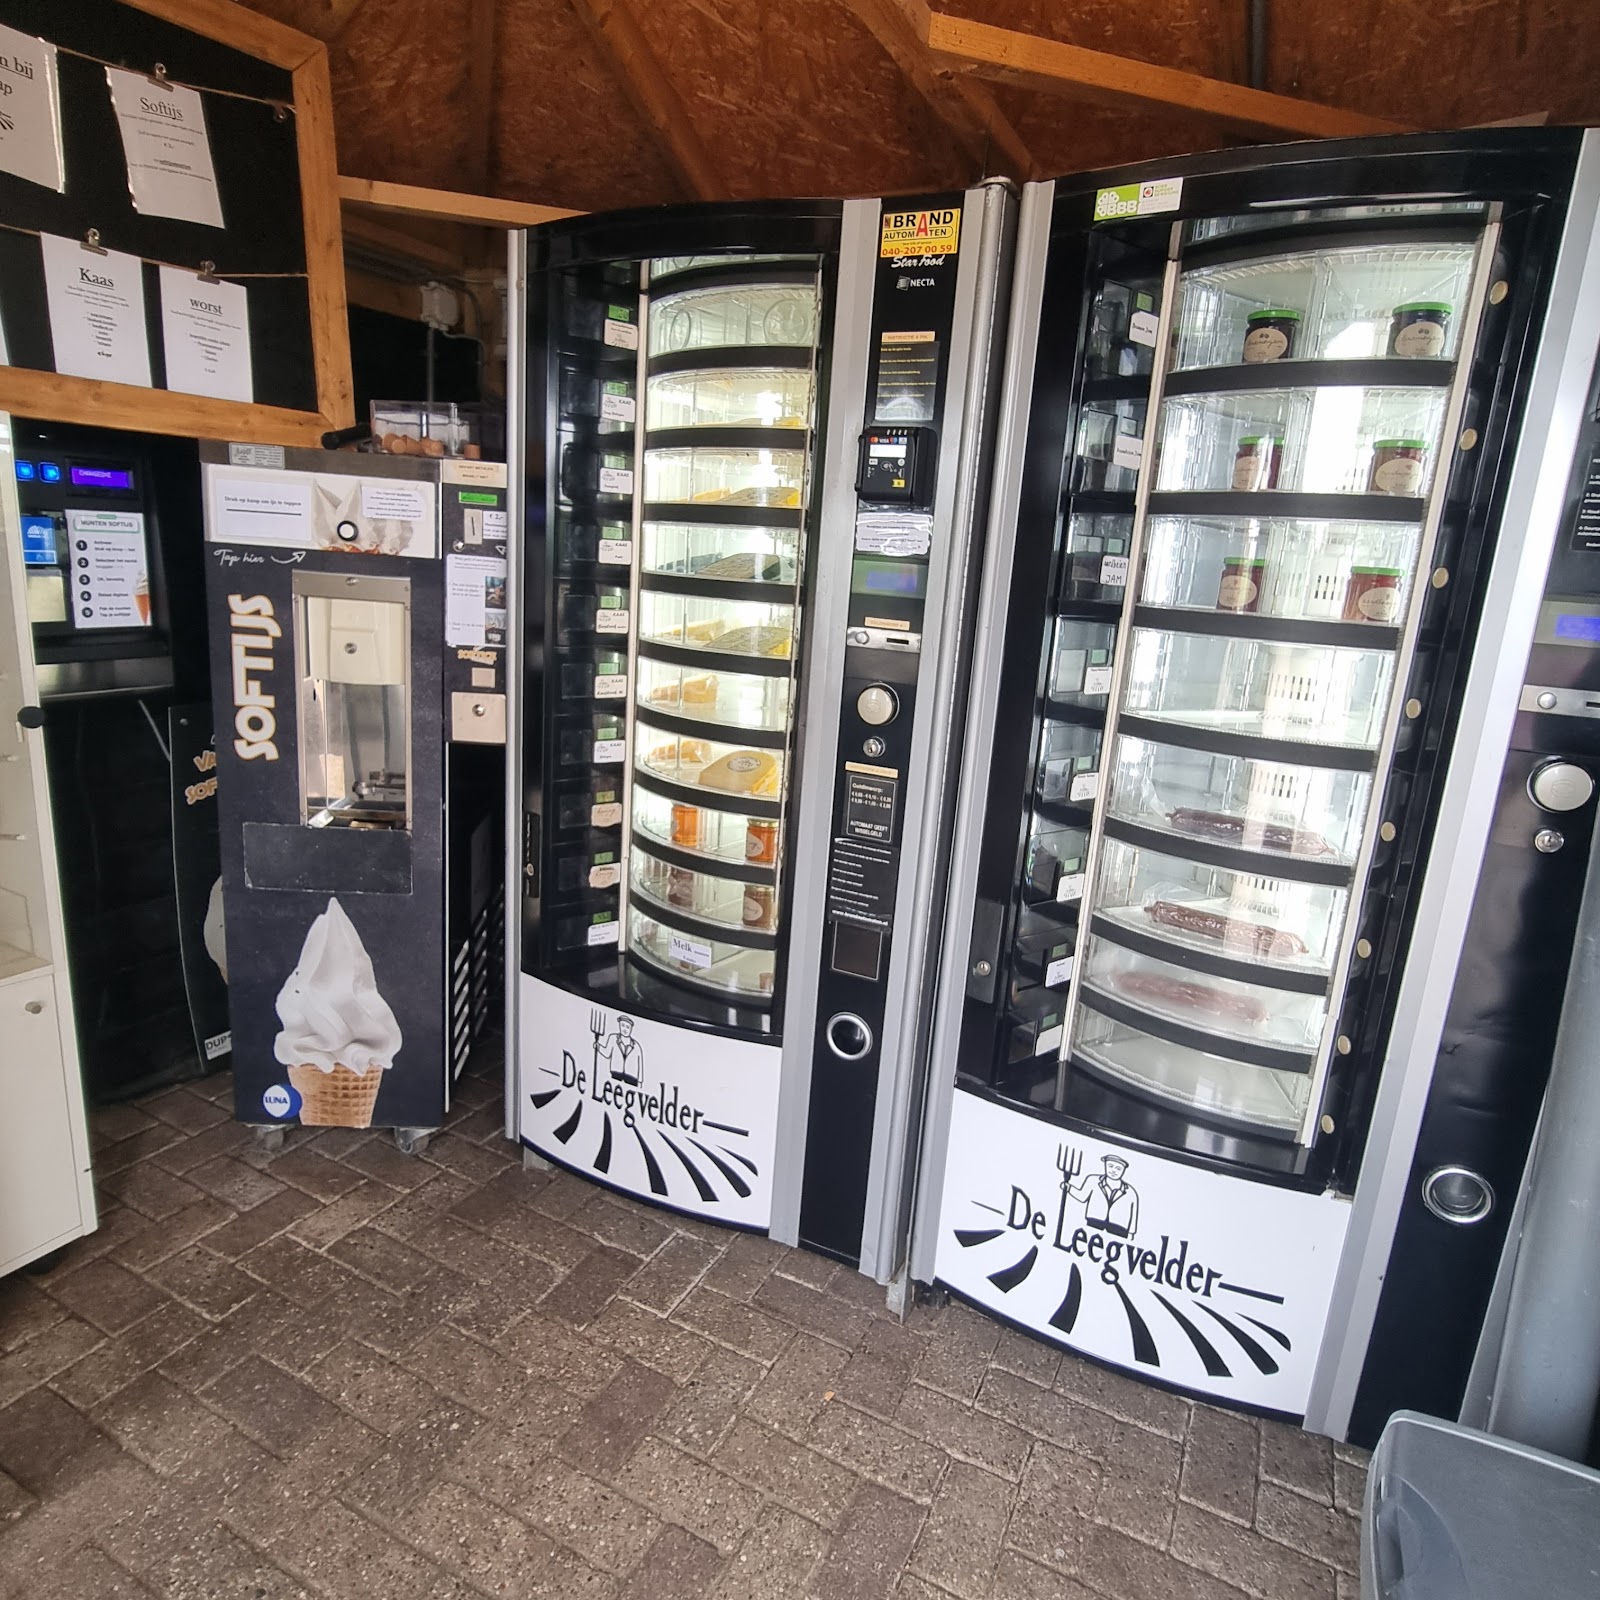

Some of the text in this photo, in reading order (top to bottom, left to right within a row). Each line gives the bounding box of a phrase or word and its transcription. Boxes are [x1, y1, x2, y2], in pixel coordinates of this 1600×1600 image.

[13, 57, 33, 79] bij
[140, 97, 184, 119] Softijs
[893, 211, 954, 234] BRAND
[884, 226, 947, 240] AUTOMATEN
[882, 244, 952, 256] 040-207 00 59
[891, 254, 946, 268] Star Food
[79, 267, 115, 287] Kaas
[910, 278, 935, 287] NECTA
[189, 299, 223, 315] worst
[213, 549, 264, 566] Tap hier
[1106, 575, 1121, 584] JAM
[227, 594, 282, 761] SOFTIJS
[673, 938, 692, 952] Melk
[562, 1049, 704, 1134] De Leegvelder
[265, 1096, 289, 1105] LUNA
[1006, 1184, 1223, 1298] De Leegvelder
